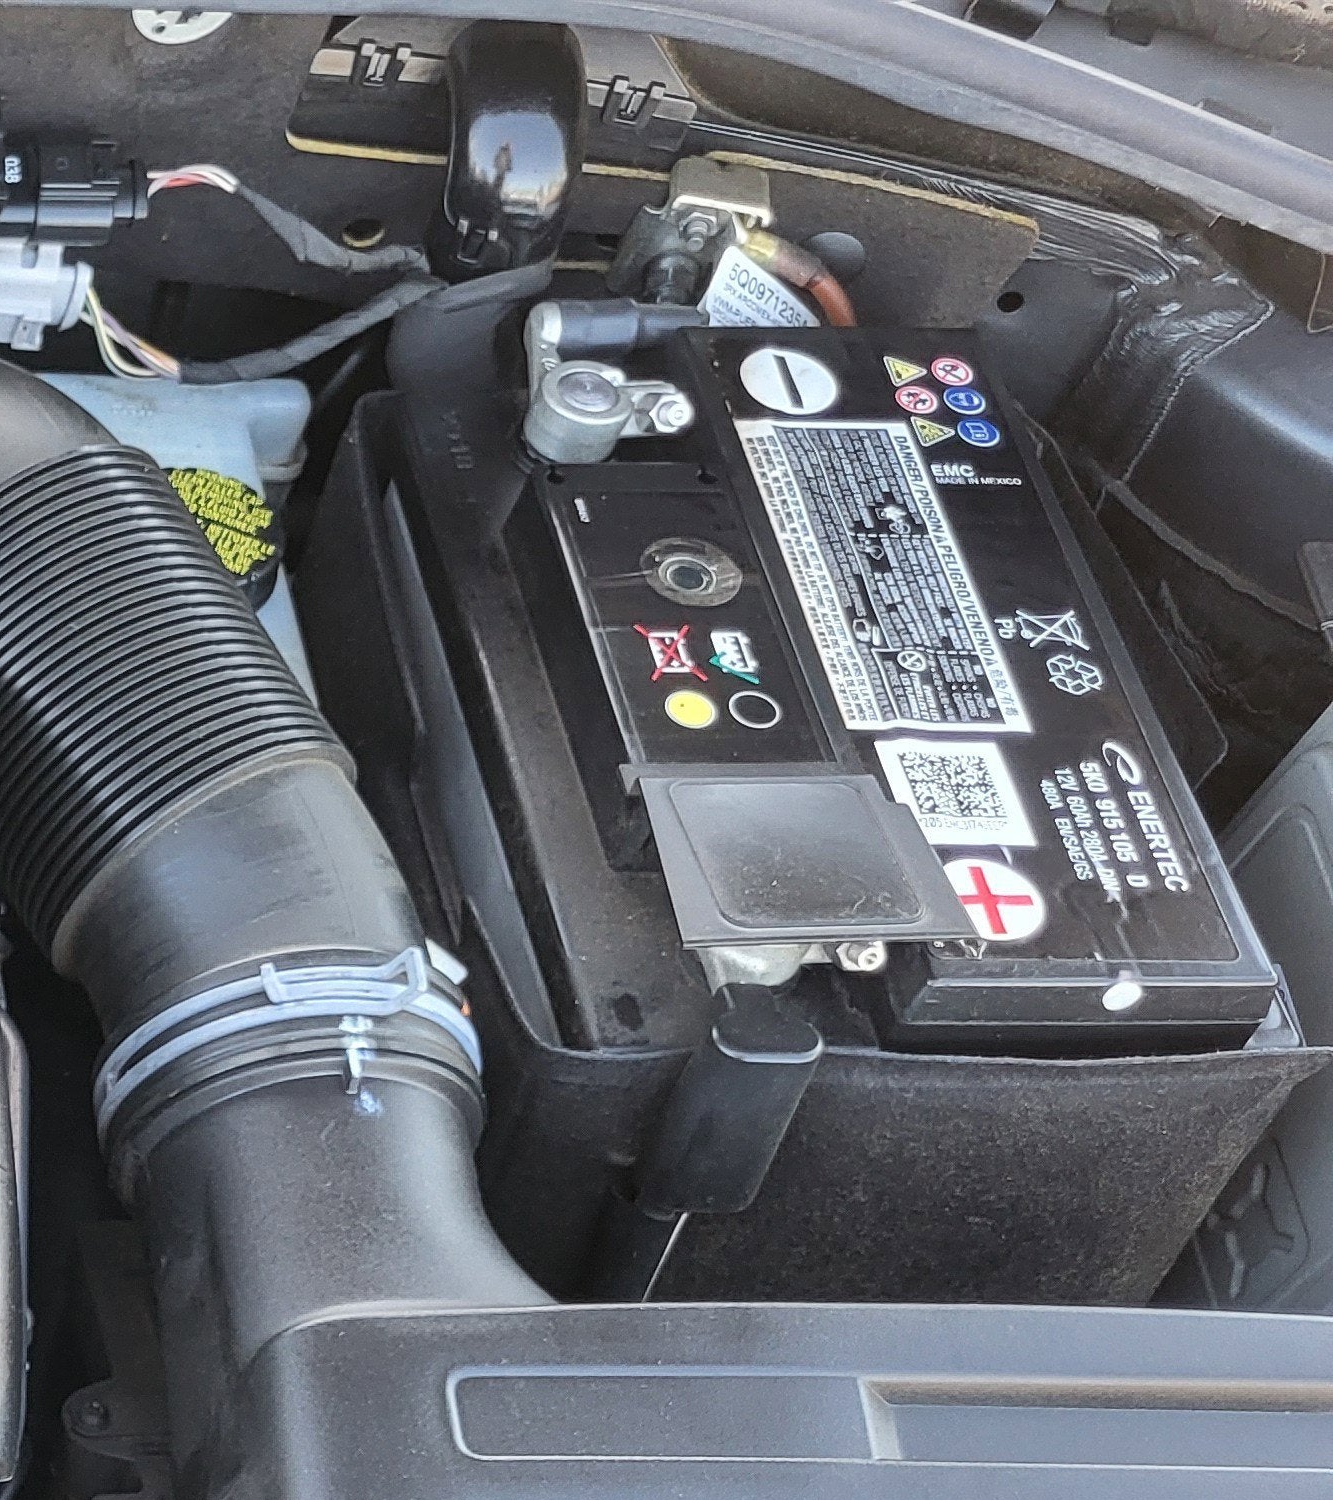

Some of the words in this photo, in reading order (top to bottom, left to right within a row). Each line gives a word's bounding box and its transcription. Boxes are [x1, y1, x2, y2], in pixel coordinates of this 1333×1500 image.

[930, 463, 974, 477] EMC
[935, 477, 966, 485] MADE
[968, 477, 979, 485] IN
[980, 477, 1022, 485] MEXICO
[893, 435, 946, 533] DANGER/POISON
[938, 544, 996, 657] PELIGRO/VENENO
[994, 617, 1015, 640] Pb
[1054, 767, 1080, 792] 12V
[1078, 761, 1105, 792] 5K0
[1066, 796, 1095, 828] 60Ah
[1094, 799, 1125, 829] 915
[1039, 779, 1063, 810] 480A
[1054, 818, 1094, 881] EN/SAE/GS
[1127, 791, 1189, 893] ENERTEC
[1079, 830, 1110, 863] 280A
[1108, 832, 1138, 863] 105
[1096, 867, 1121, 891] DIN
[1125, 874, 1149, 888] D
